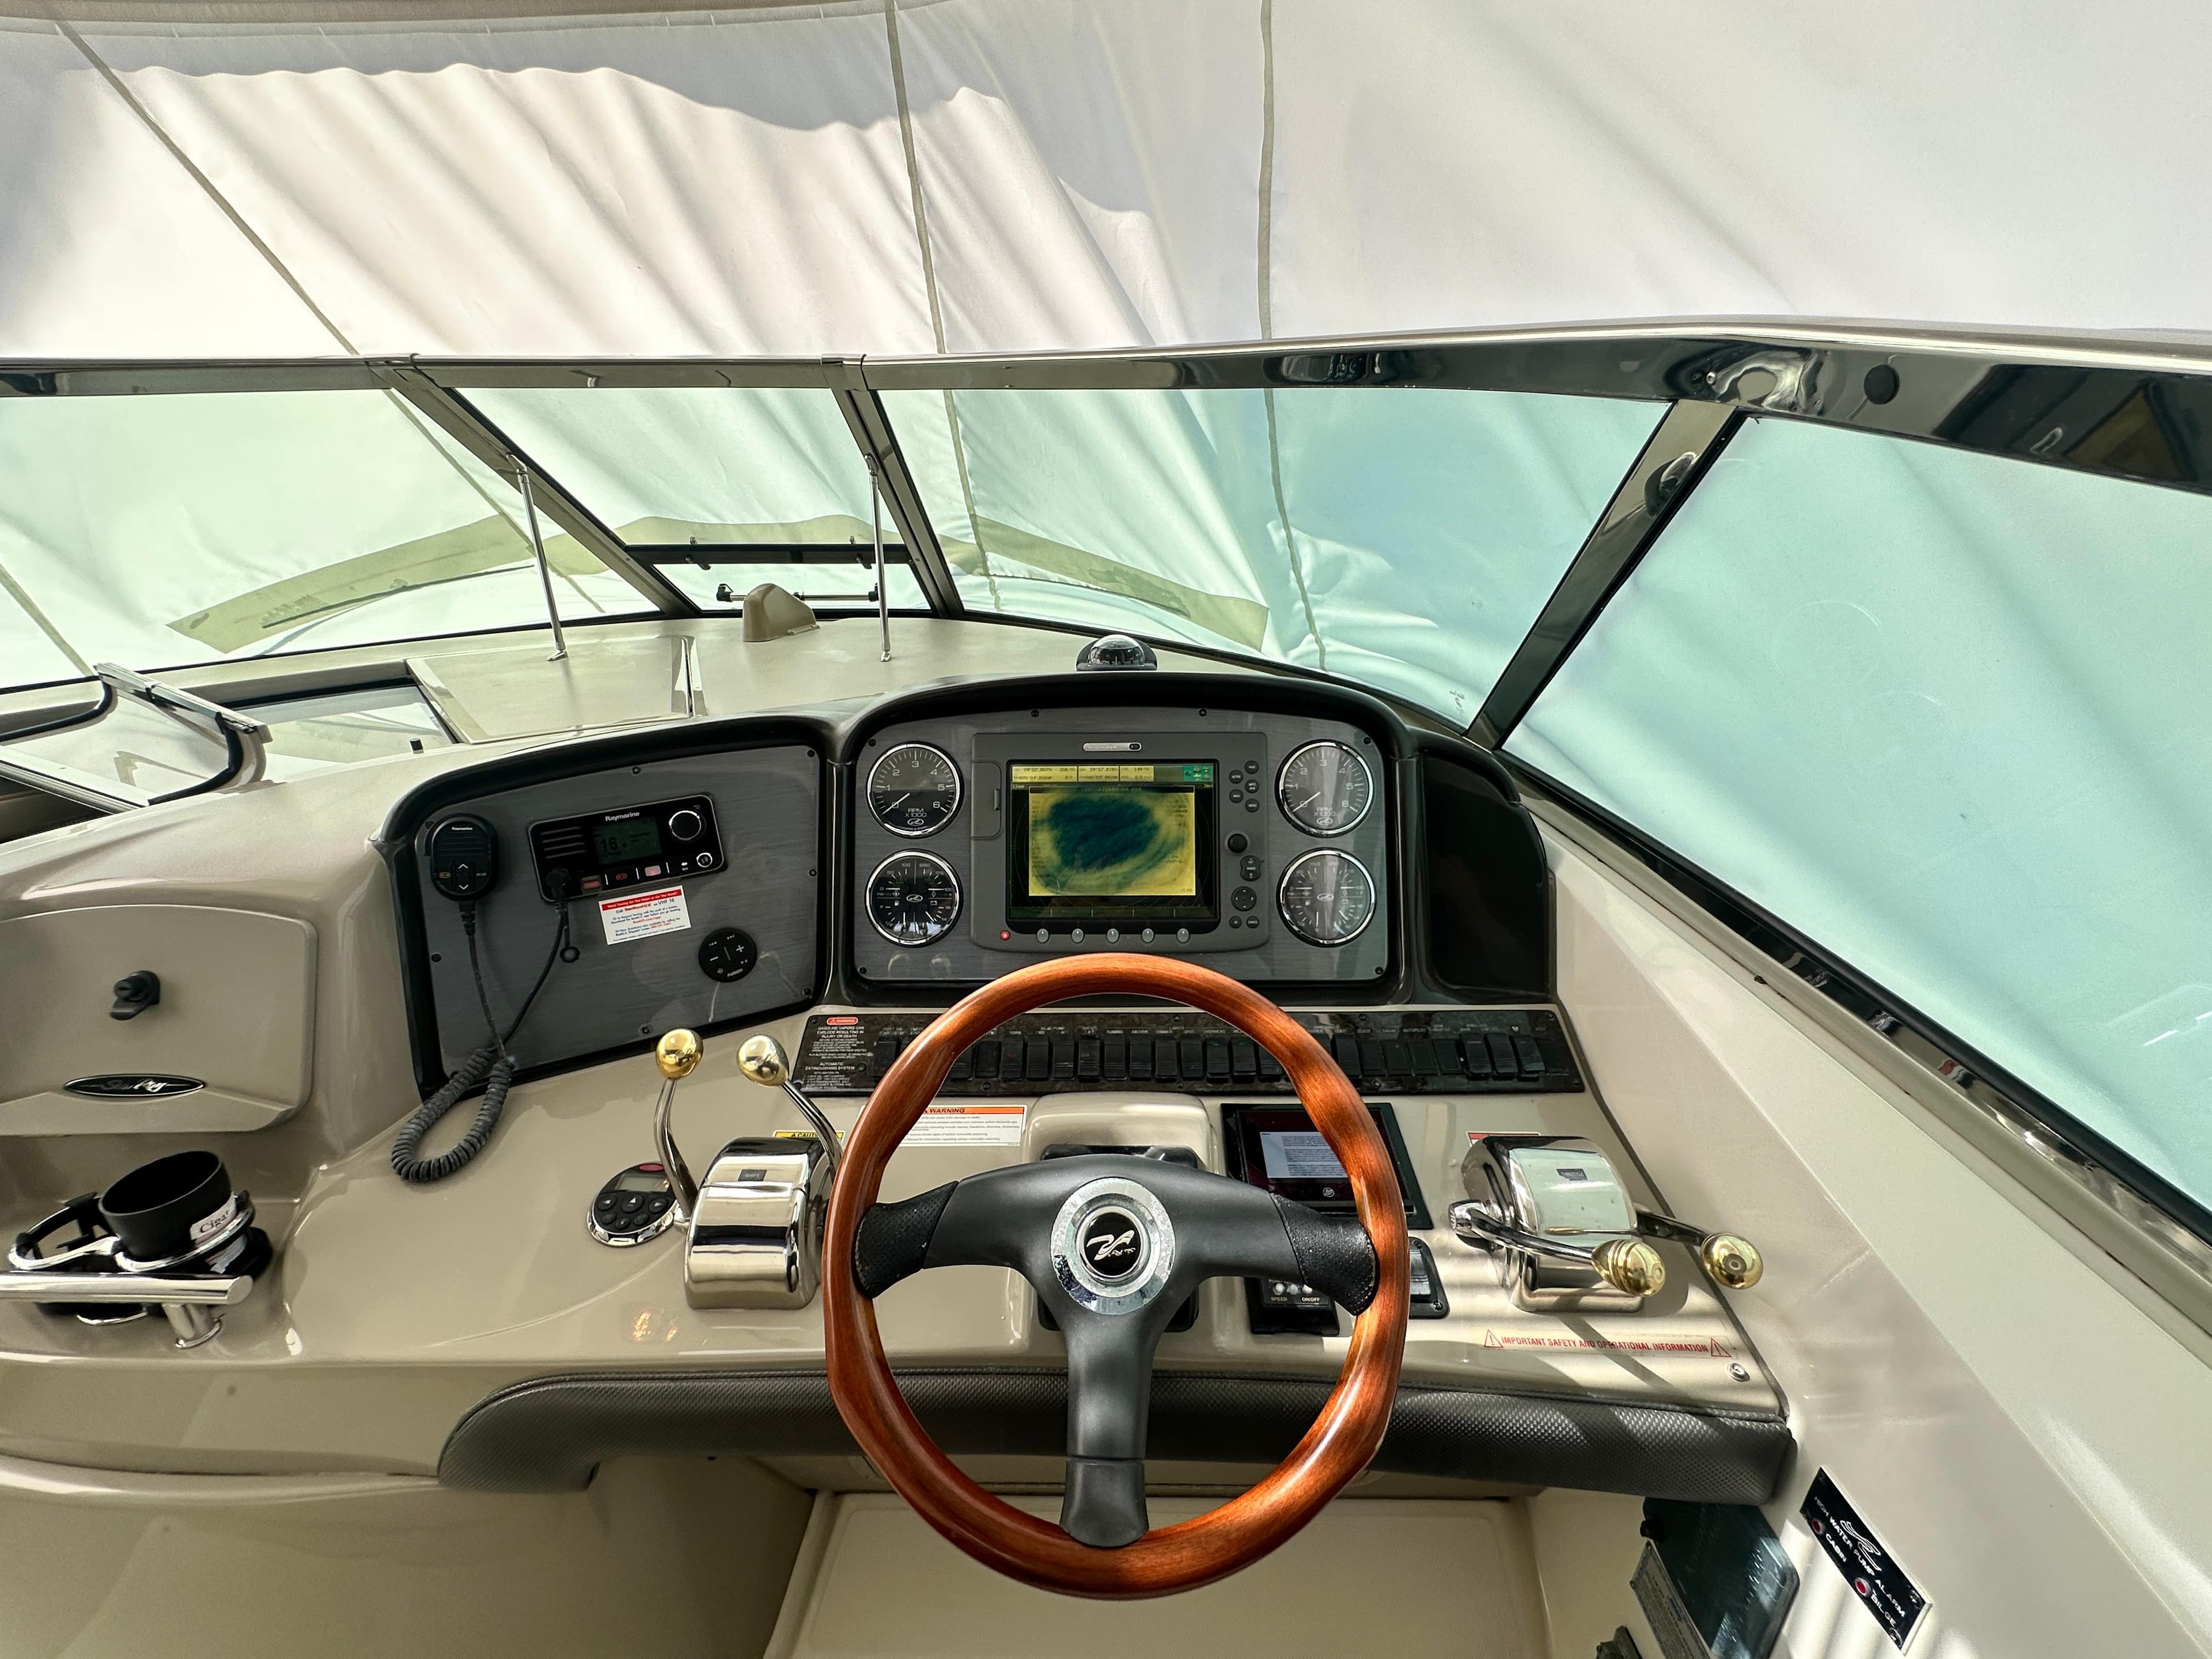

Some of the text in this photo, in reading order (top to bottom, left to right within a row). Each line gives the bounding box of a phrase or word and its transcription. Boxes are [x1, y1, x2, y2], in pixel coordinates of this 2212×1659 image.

[605, 812, 640, 821] Raymarine
[200, 1210, 230, 1233] Cigar
[1501, 1336, 1709, 1353] IMPORTANT SAFETY AND OPERATIONAL INFORMATION
[1825, 1533, 1847, 1563] CABIN
[1830, 1516, 1854, 1550] WATER
[1853, 1549, 1875, 1576] PUMP
[1875, 1579, 1906, 1618] ALARM
[1871, 1594, 1896, 1627] BILGE
